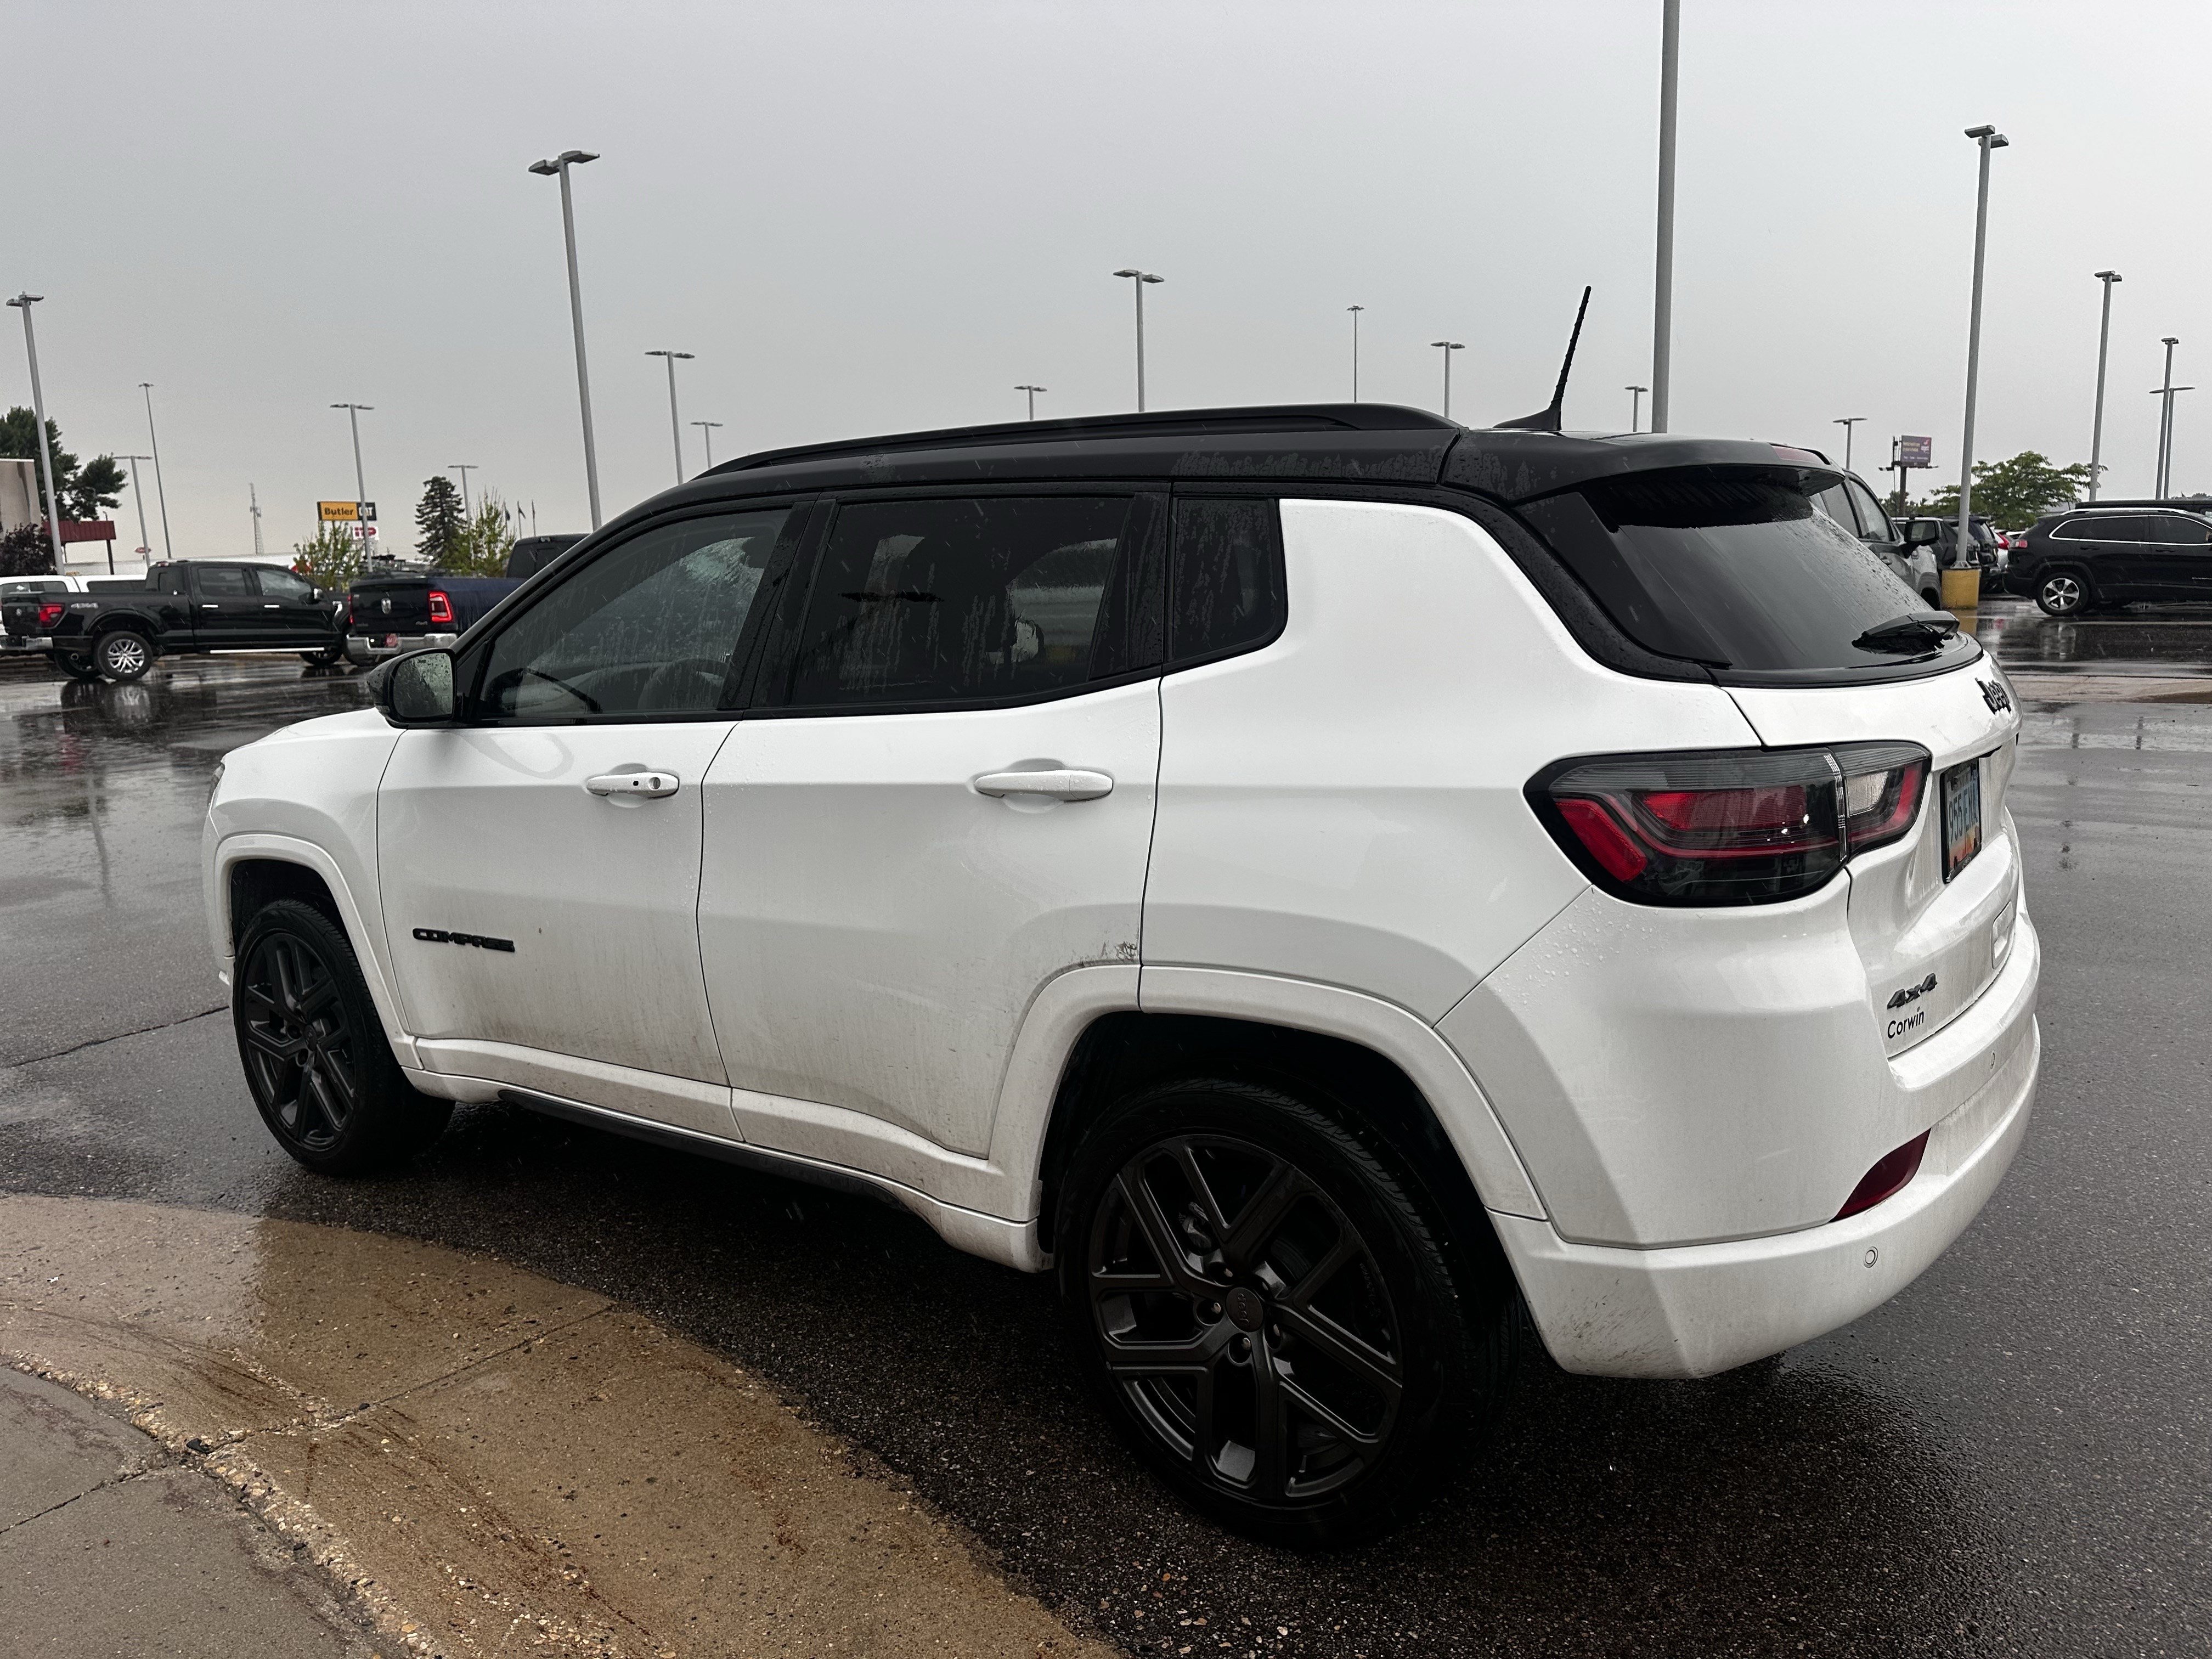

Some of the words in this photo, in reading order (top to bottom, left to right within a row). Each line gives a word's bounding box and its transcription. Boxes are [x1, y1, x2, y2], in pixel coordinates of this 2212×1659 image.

[324, 507, 354, 516] Butler
[1975, 678, 2012, 715] Jeep
[1949, 793, 1963, 843] 955
[1887, 973, 1938, 1010] 4x4
[1887, 1006, 1924, 1039] Corwin
[1237, 1293, 1250, 1326] Jeep
